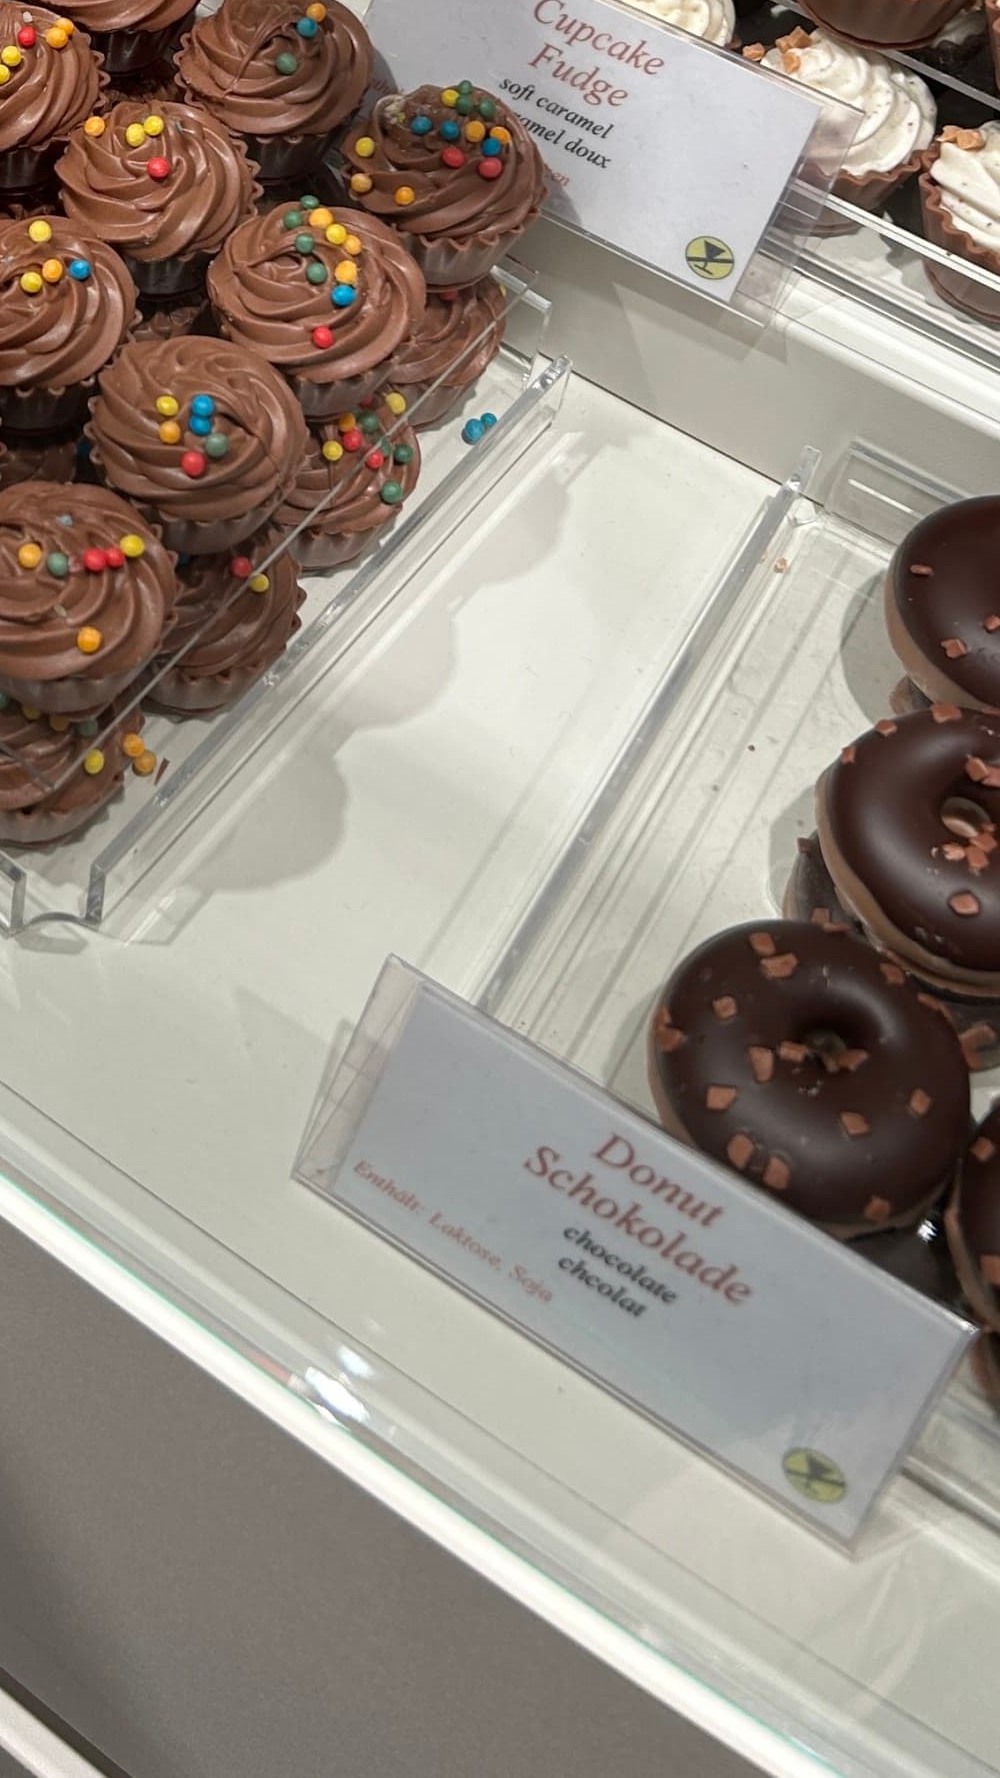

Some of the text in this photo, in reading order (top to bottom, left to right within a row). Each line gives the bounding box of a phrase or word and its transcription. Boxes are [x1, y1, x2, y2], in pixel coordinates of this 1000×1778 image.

[528, 41, 630, 108] Fudge
[499, 78, 614, 139] soft caramel
[565, 138, 611, 169] doux
[590, 1130, 728, 1230] Donut
[522, 1143, 755, 1307] Schokolade
[511, 1264, 554, 1303] Soja
[557, 1257, 647, 1317] chcolat
[563, 1226, 677, 1304] chocolate
